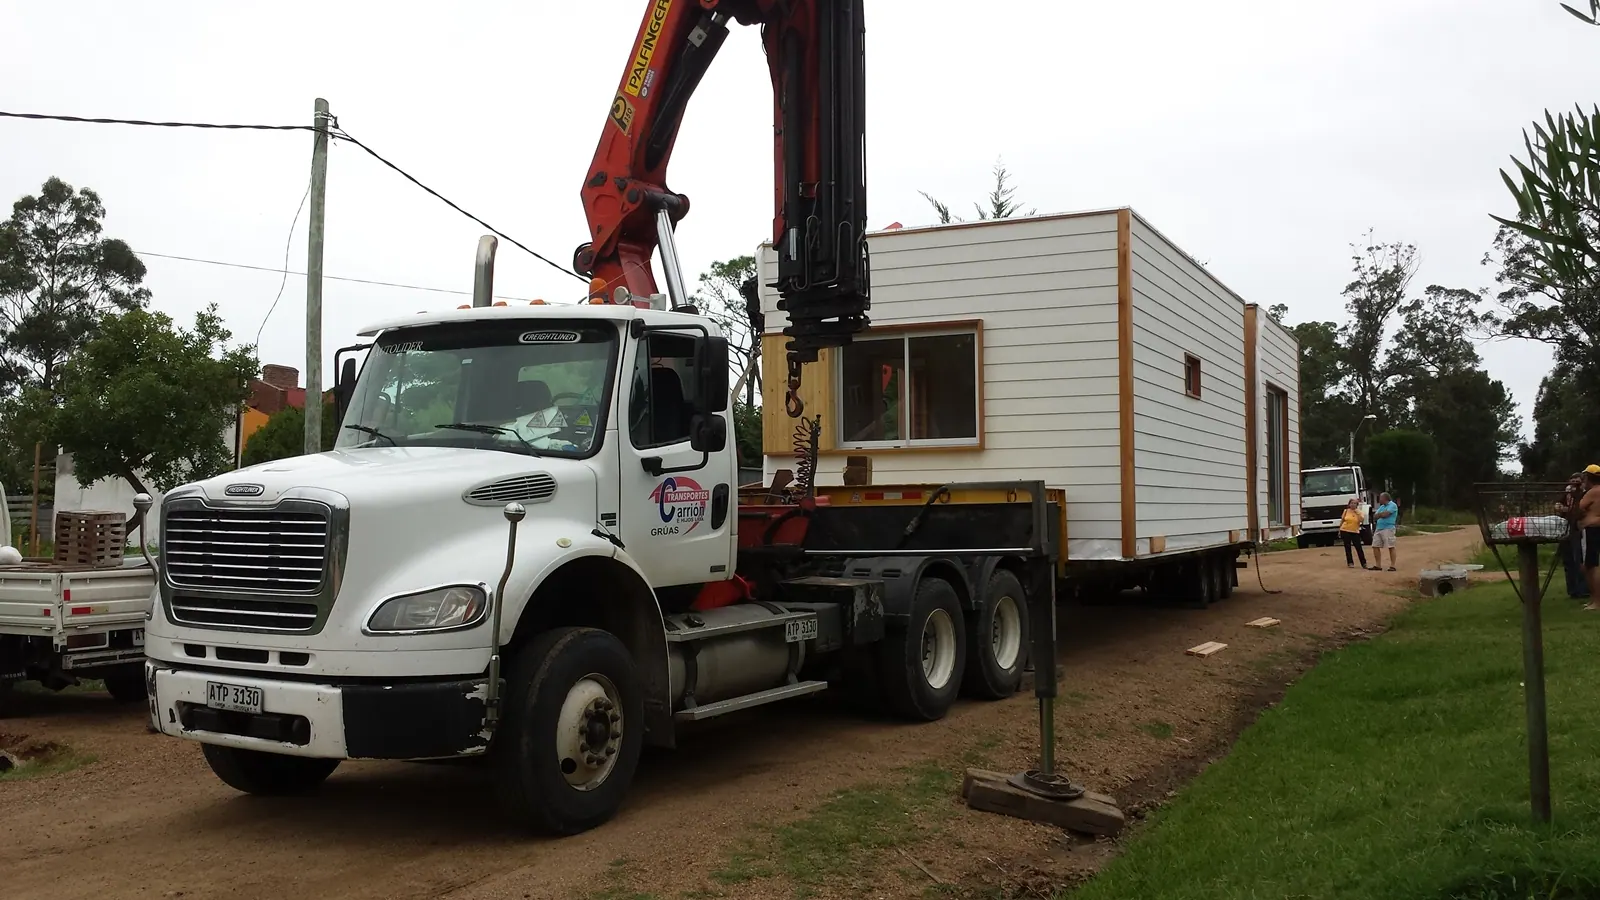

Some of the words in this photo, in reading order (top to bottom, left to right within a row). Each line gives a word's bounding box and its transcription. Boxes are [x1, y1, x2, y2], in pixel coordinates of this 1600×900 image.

[629, 0, 669, 89] PALFINGER
[524, 333, 576, 341] FREIGHTLINER
[667, 491, 708, 502] TRANSPORTES
[650, 525, 680, 536] GRÚAS
[788, 622, 799, 636] ATP
[802, 620, 817, 634] 3130
[210, 684, 229, 702] ATP
[232, 687, 259, 706] 3130
